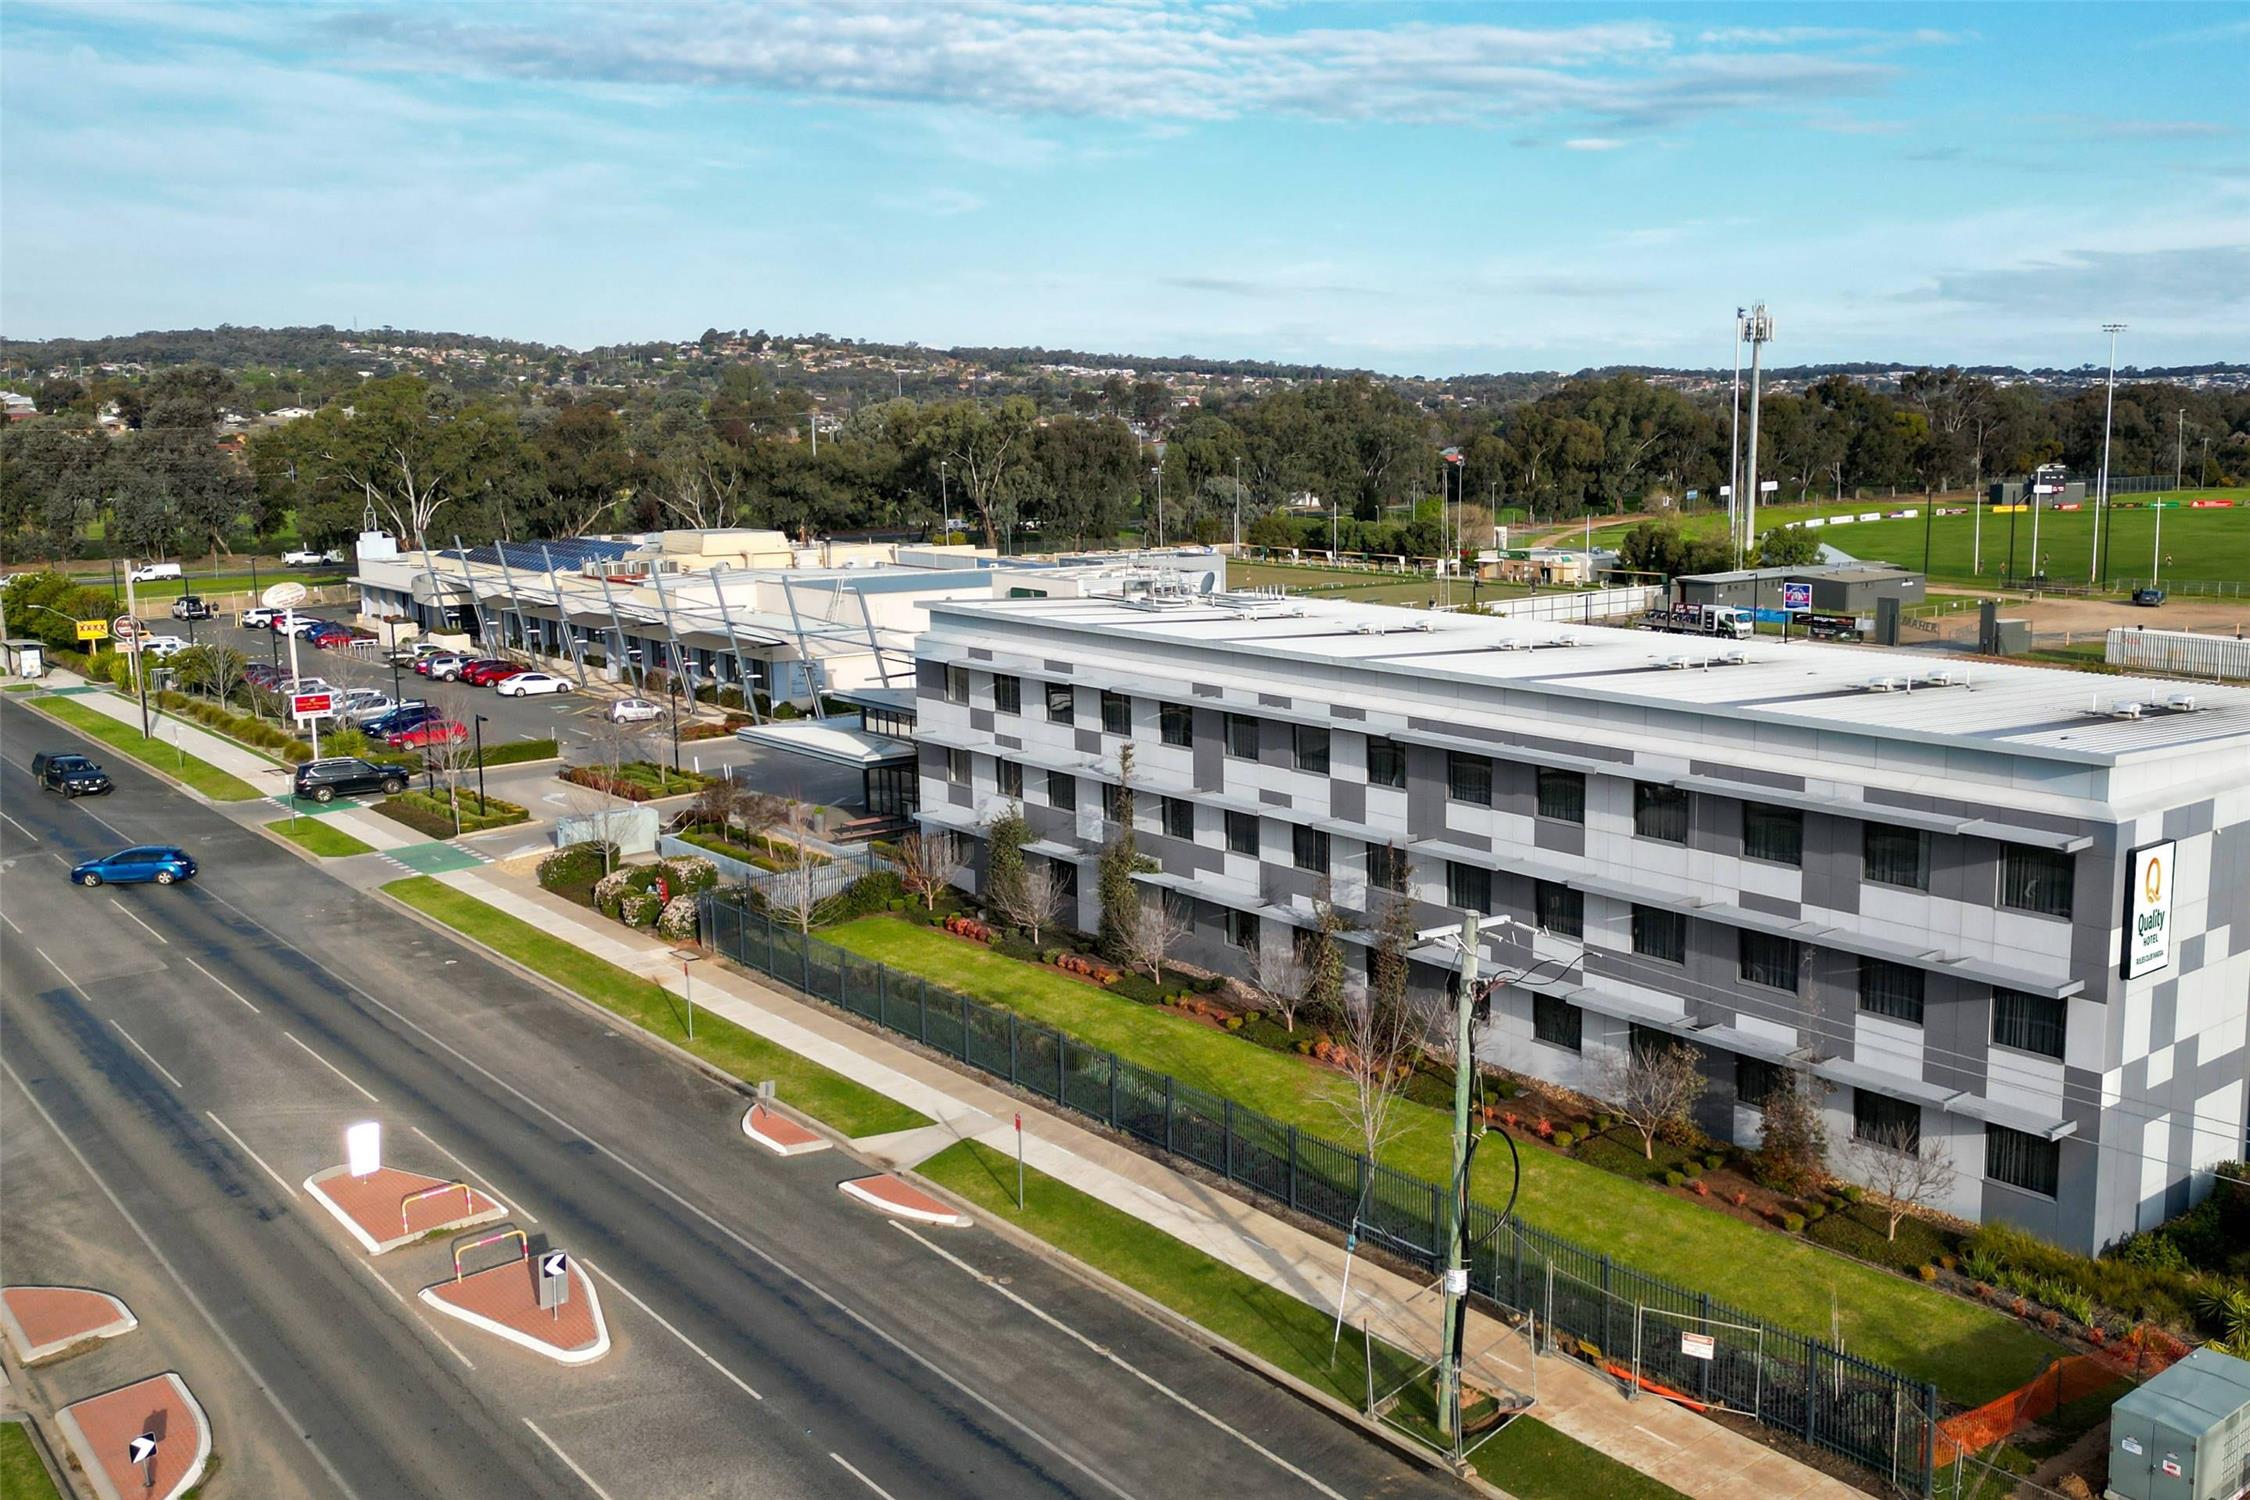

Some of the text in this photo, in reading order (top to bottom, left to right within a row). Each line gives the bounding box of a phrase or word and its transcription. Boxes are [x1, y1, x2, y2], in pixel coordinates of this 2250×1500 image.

[80, 624, 106, 632] XXXX
[1901, 616, 1938, 633] MAHER
[2138, 909, 2165, 937] Quality
[2143, 934, 2158, 947] HOTEL
